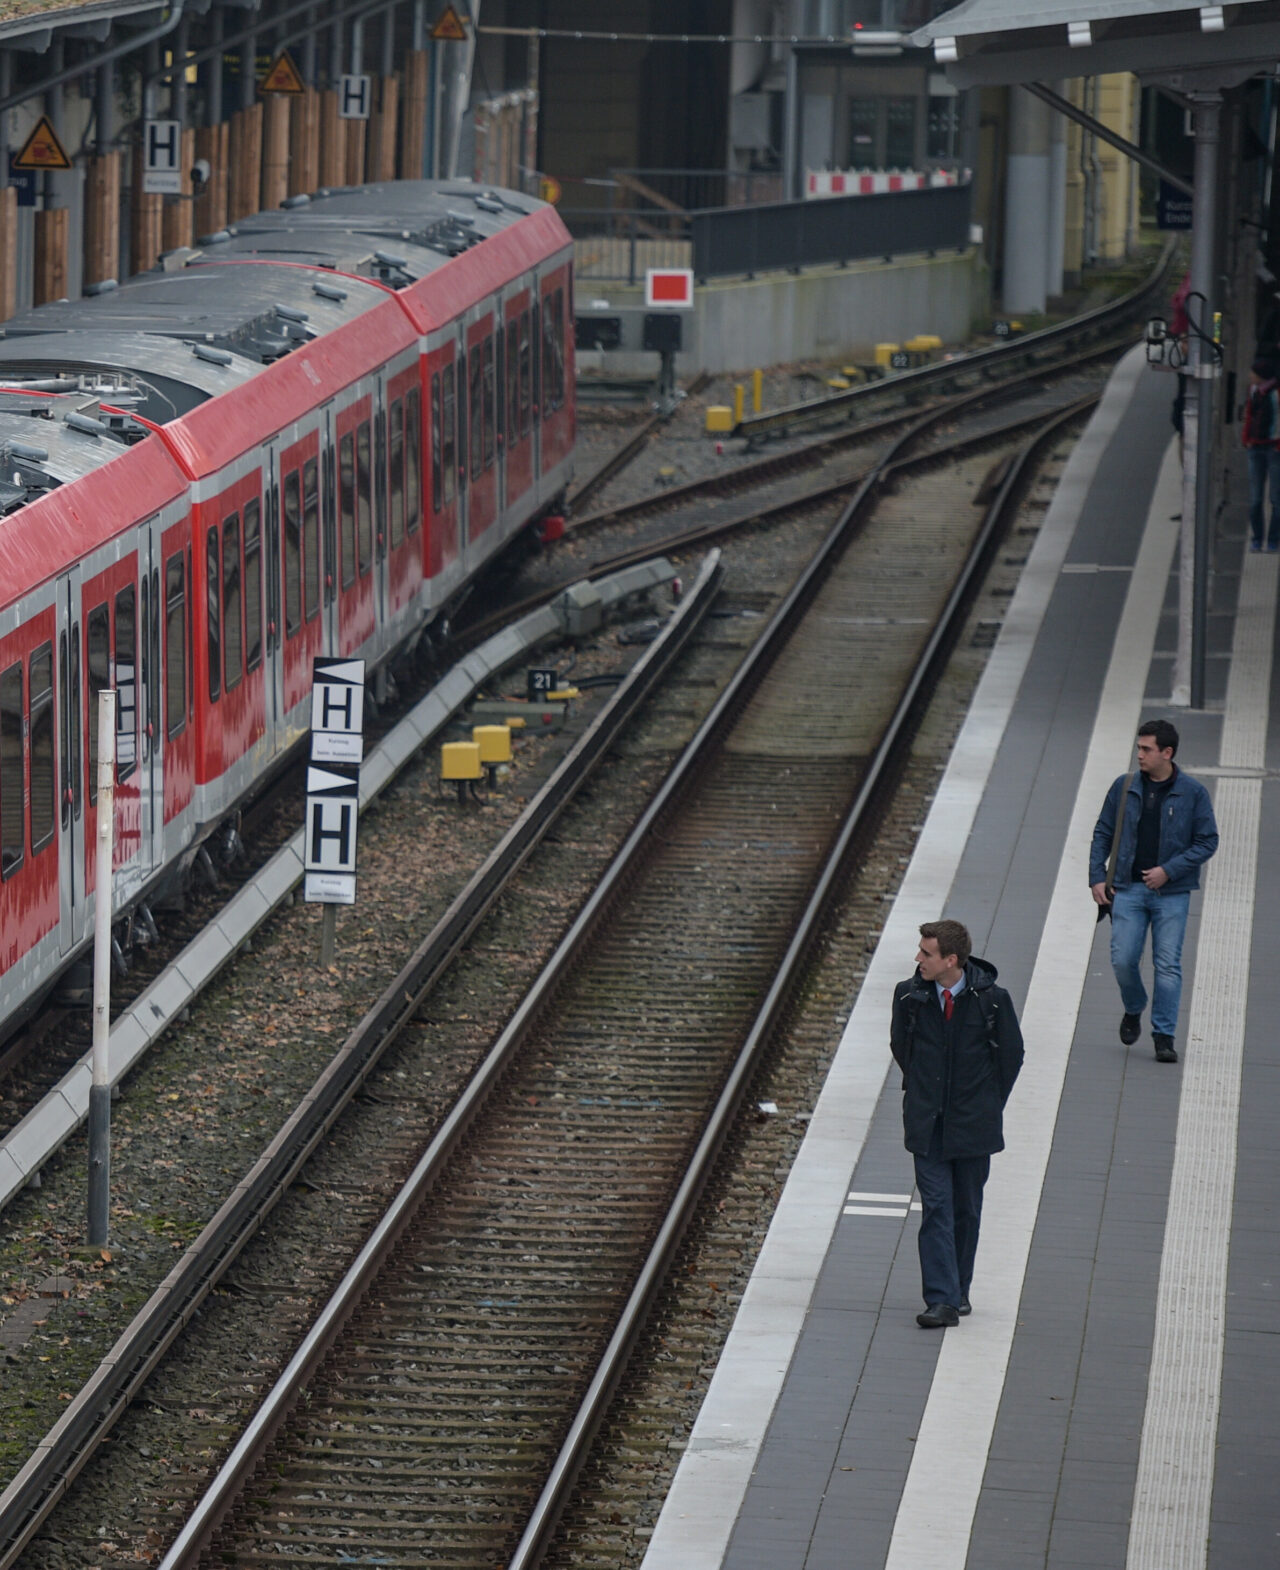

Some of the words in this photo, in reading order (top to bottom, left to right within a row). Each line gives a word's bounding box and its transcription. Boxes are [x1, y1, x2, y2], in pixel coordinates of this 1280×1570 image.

[343, 79, 366, 114] H
[150, 125, 175, 167] H
[534, 672, 551, 689] 21
[322, 686, 352, 729] H
[311, 803, 351, 865] H
